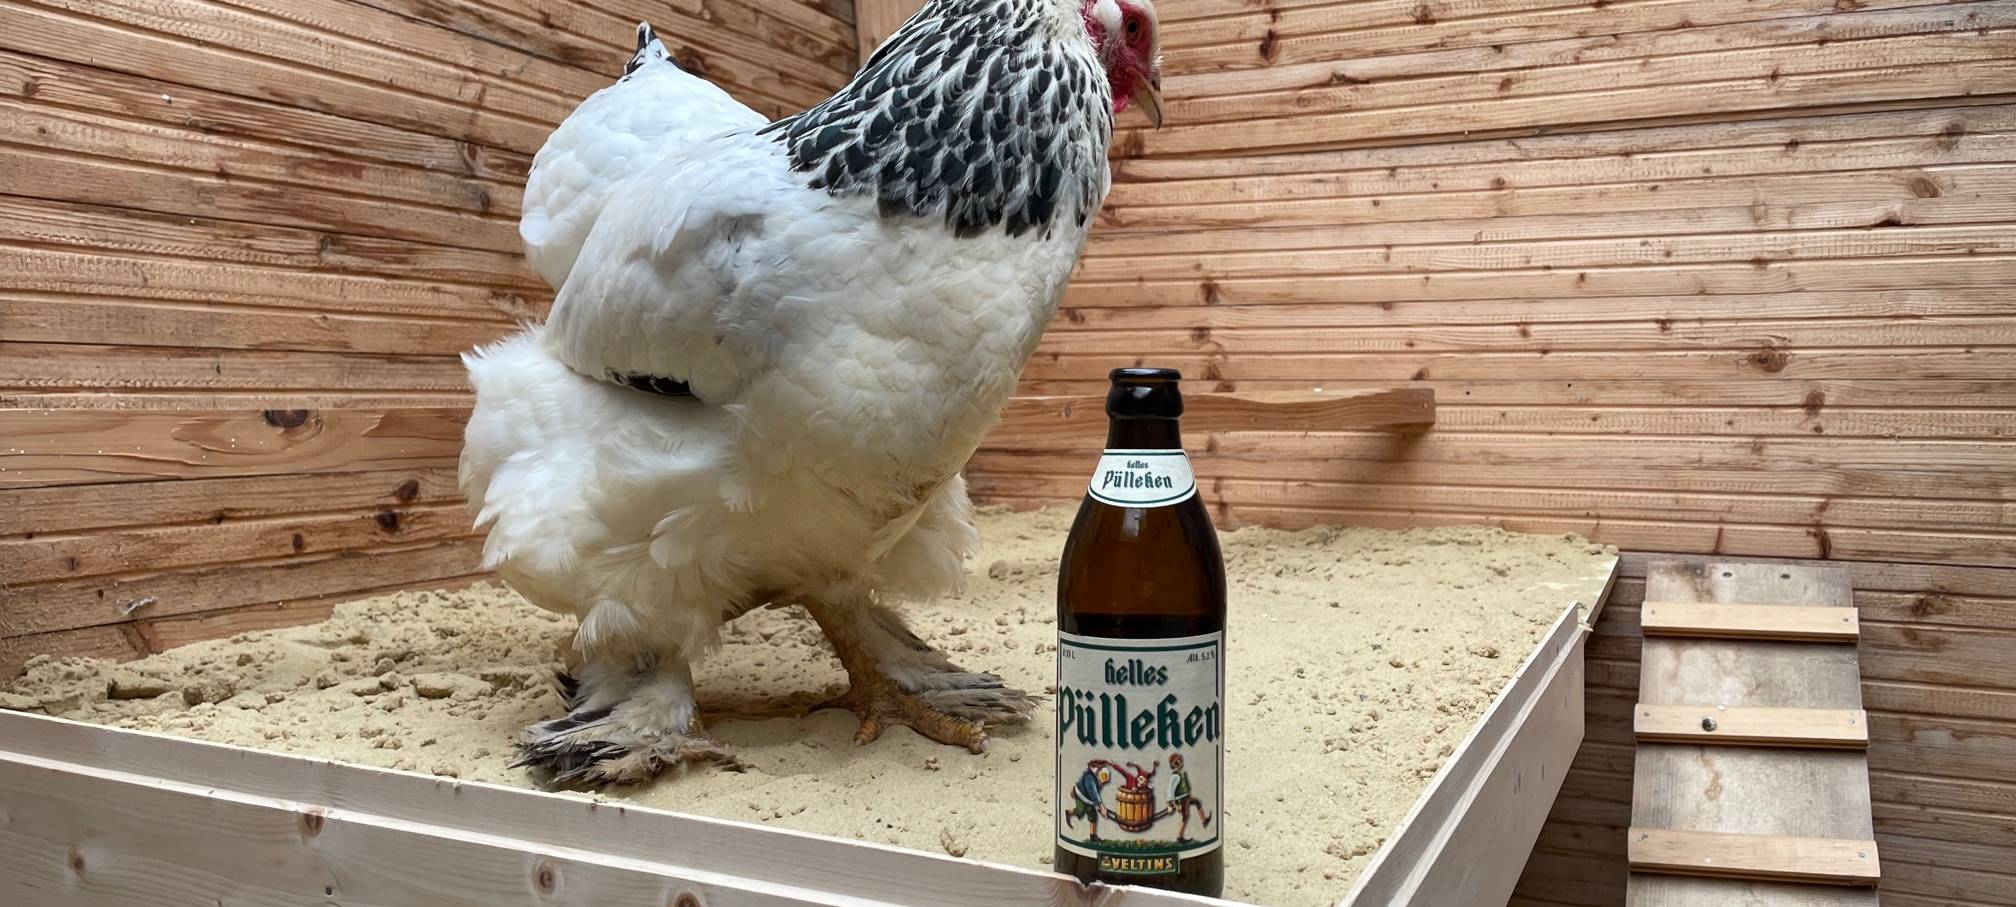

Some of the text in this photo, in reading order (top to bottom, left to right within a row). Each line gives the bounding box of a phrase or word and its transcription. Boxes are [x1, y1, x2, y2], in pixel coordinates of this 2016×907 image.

[1126, 460, 1149, 469] helles
[1102, 470, 1173, 489] Pülleken
[1105, 657, 1168, 685] helles
[1059, 685, 1220, 750] Pülleken
[1111, 857, 1173, 871] VELTINS
